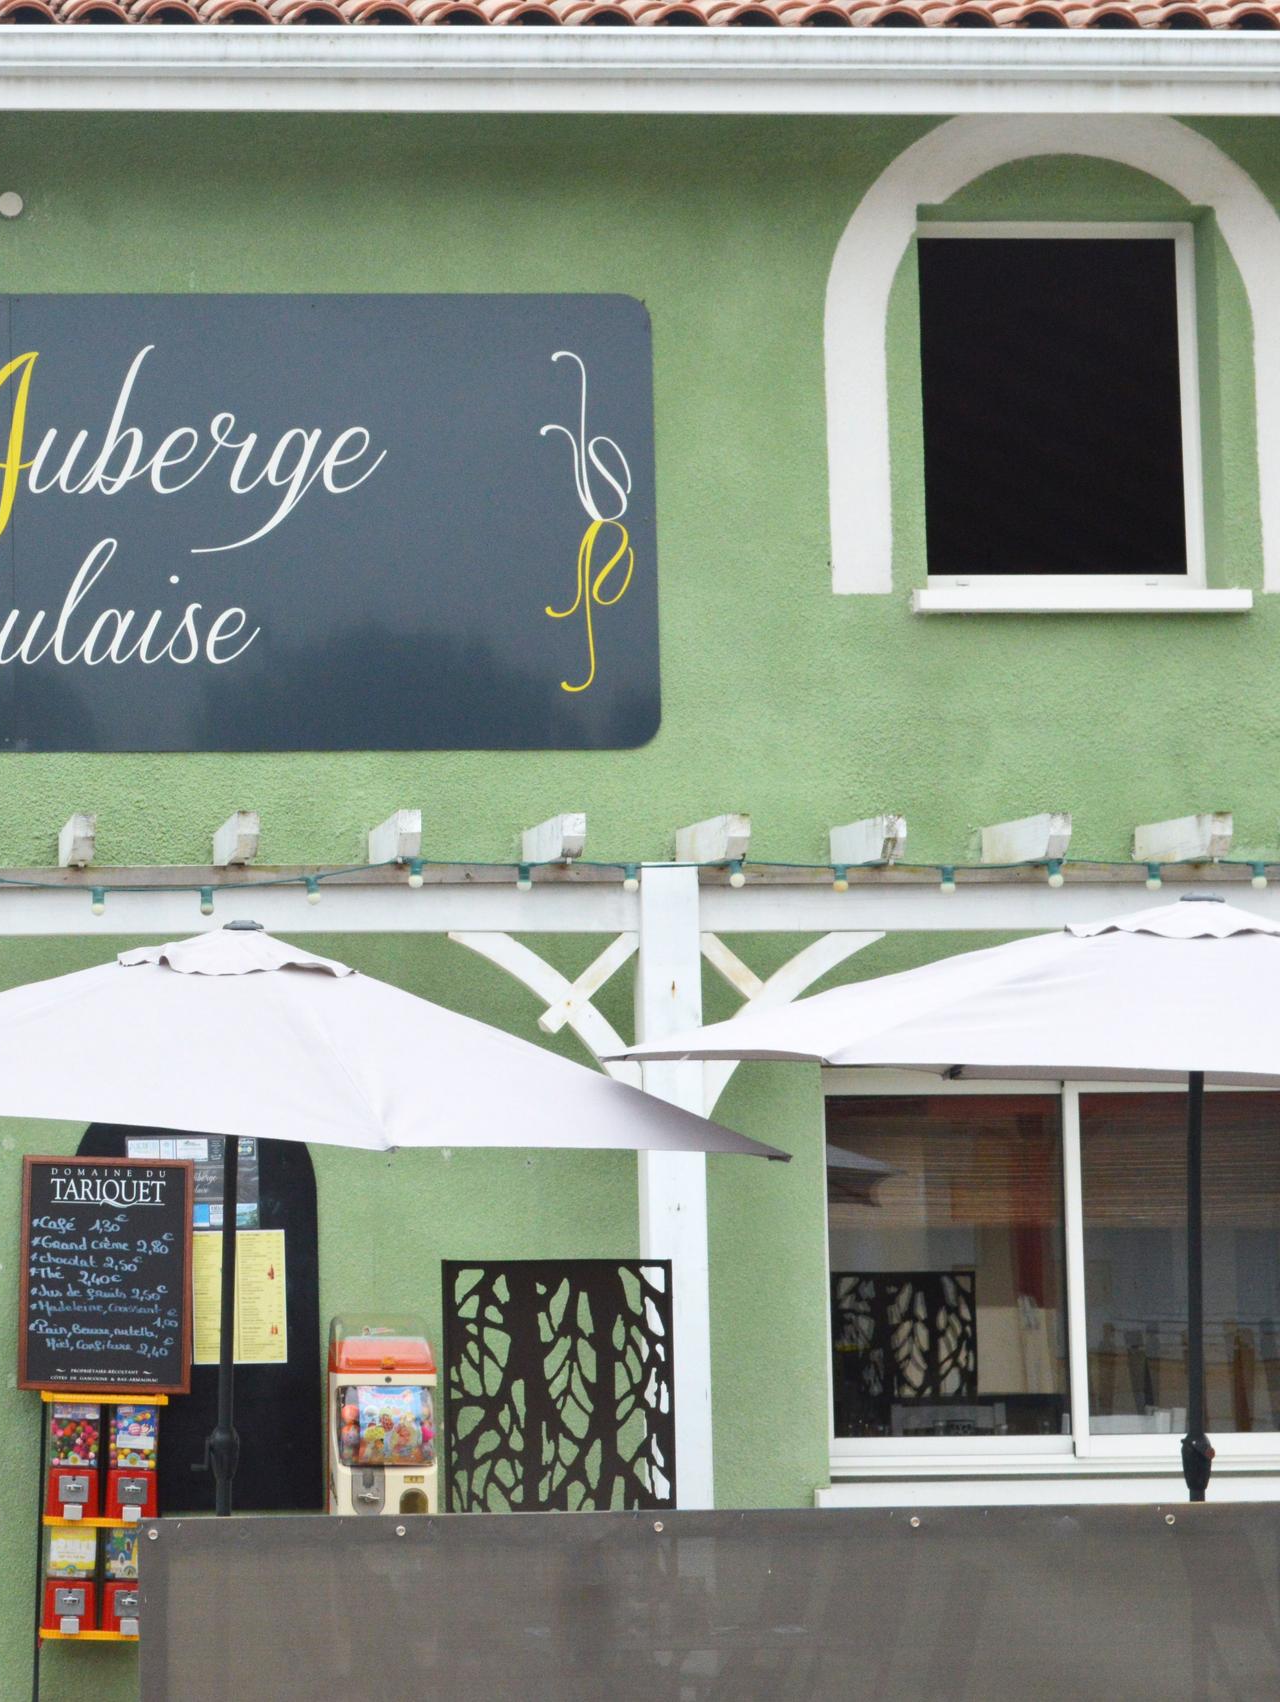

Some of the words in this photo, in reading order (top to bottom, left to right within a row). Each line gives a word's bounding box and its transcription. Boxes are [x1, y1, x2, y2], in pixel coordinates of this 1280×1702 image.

[51, 1167, 133, 1177] DOMAINE
[146, 1170, 166, 1178] DU
[50, 1178, 166, 1208] TARIQUET
[41, 1236, 87, 1251] Grand
[66, 1283, 82, 1297] de
